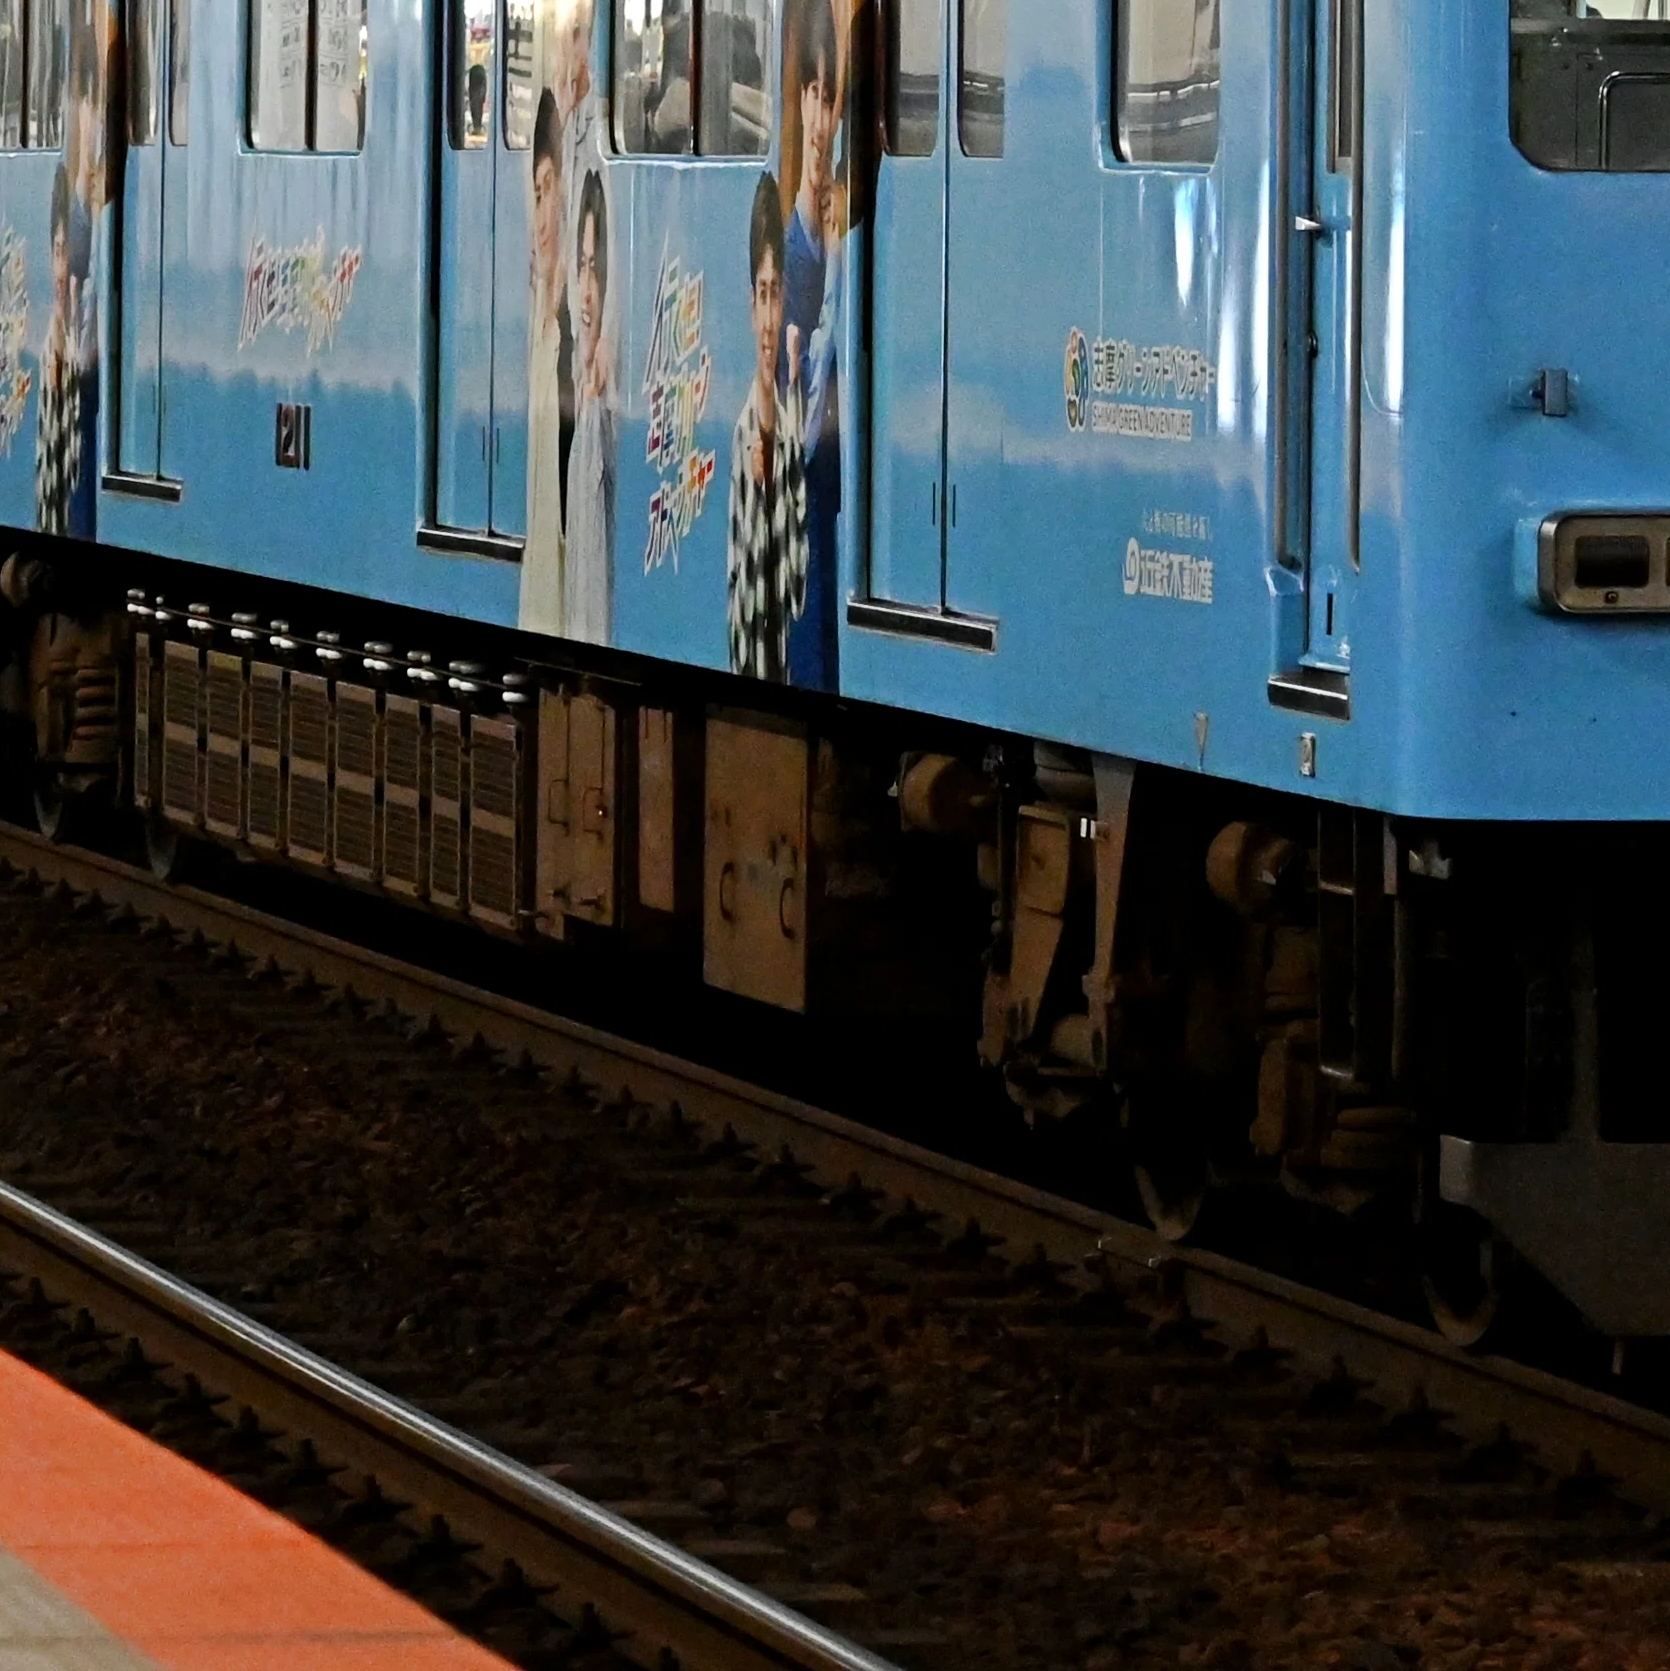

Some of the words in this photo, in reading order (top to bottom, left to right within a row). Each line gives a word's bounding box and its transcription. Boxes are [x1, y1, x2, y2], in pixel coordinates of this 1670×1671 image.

[1140, 549, 1213, 604] 近鉄不動産
